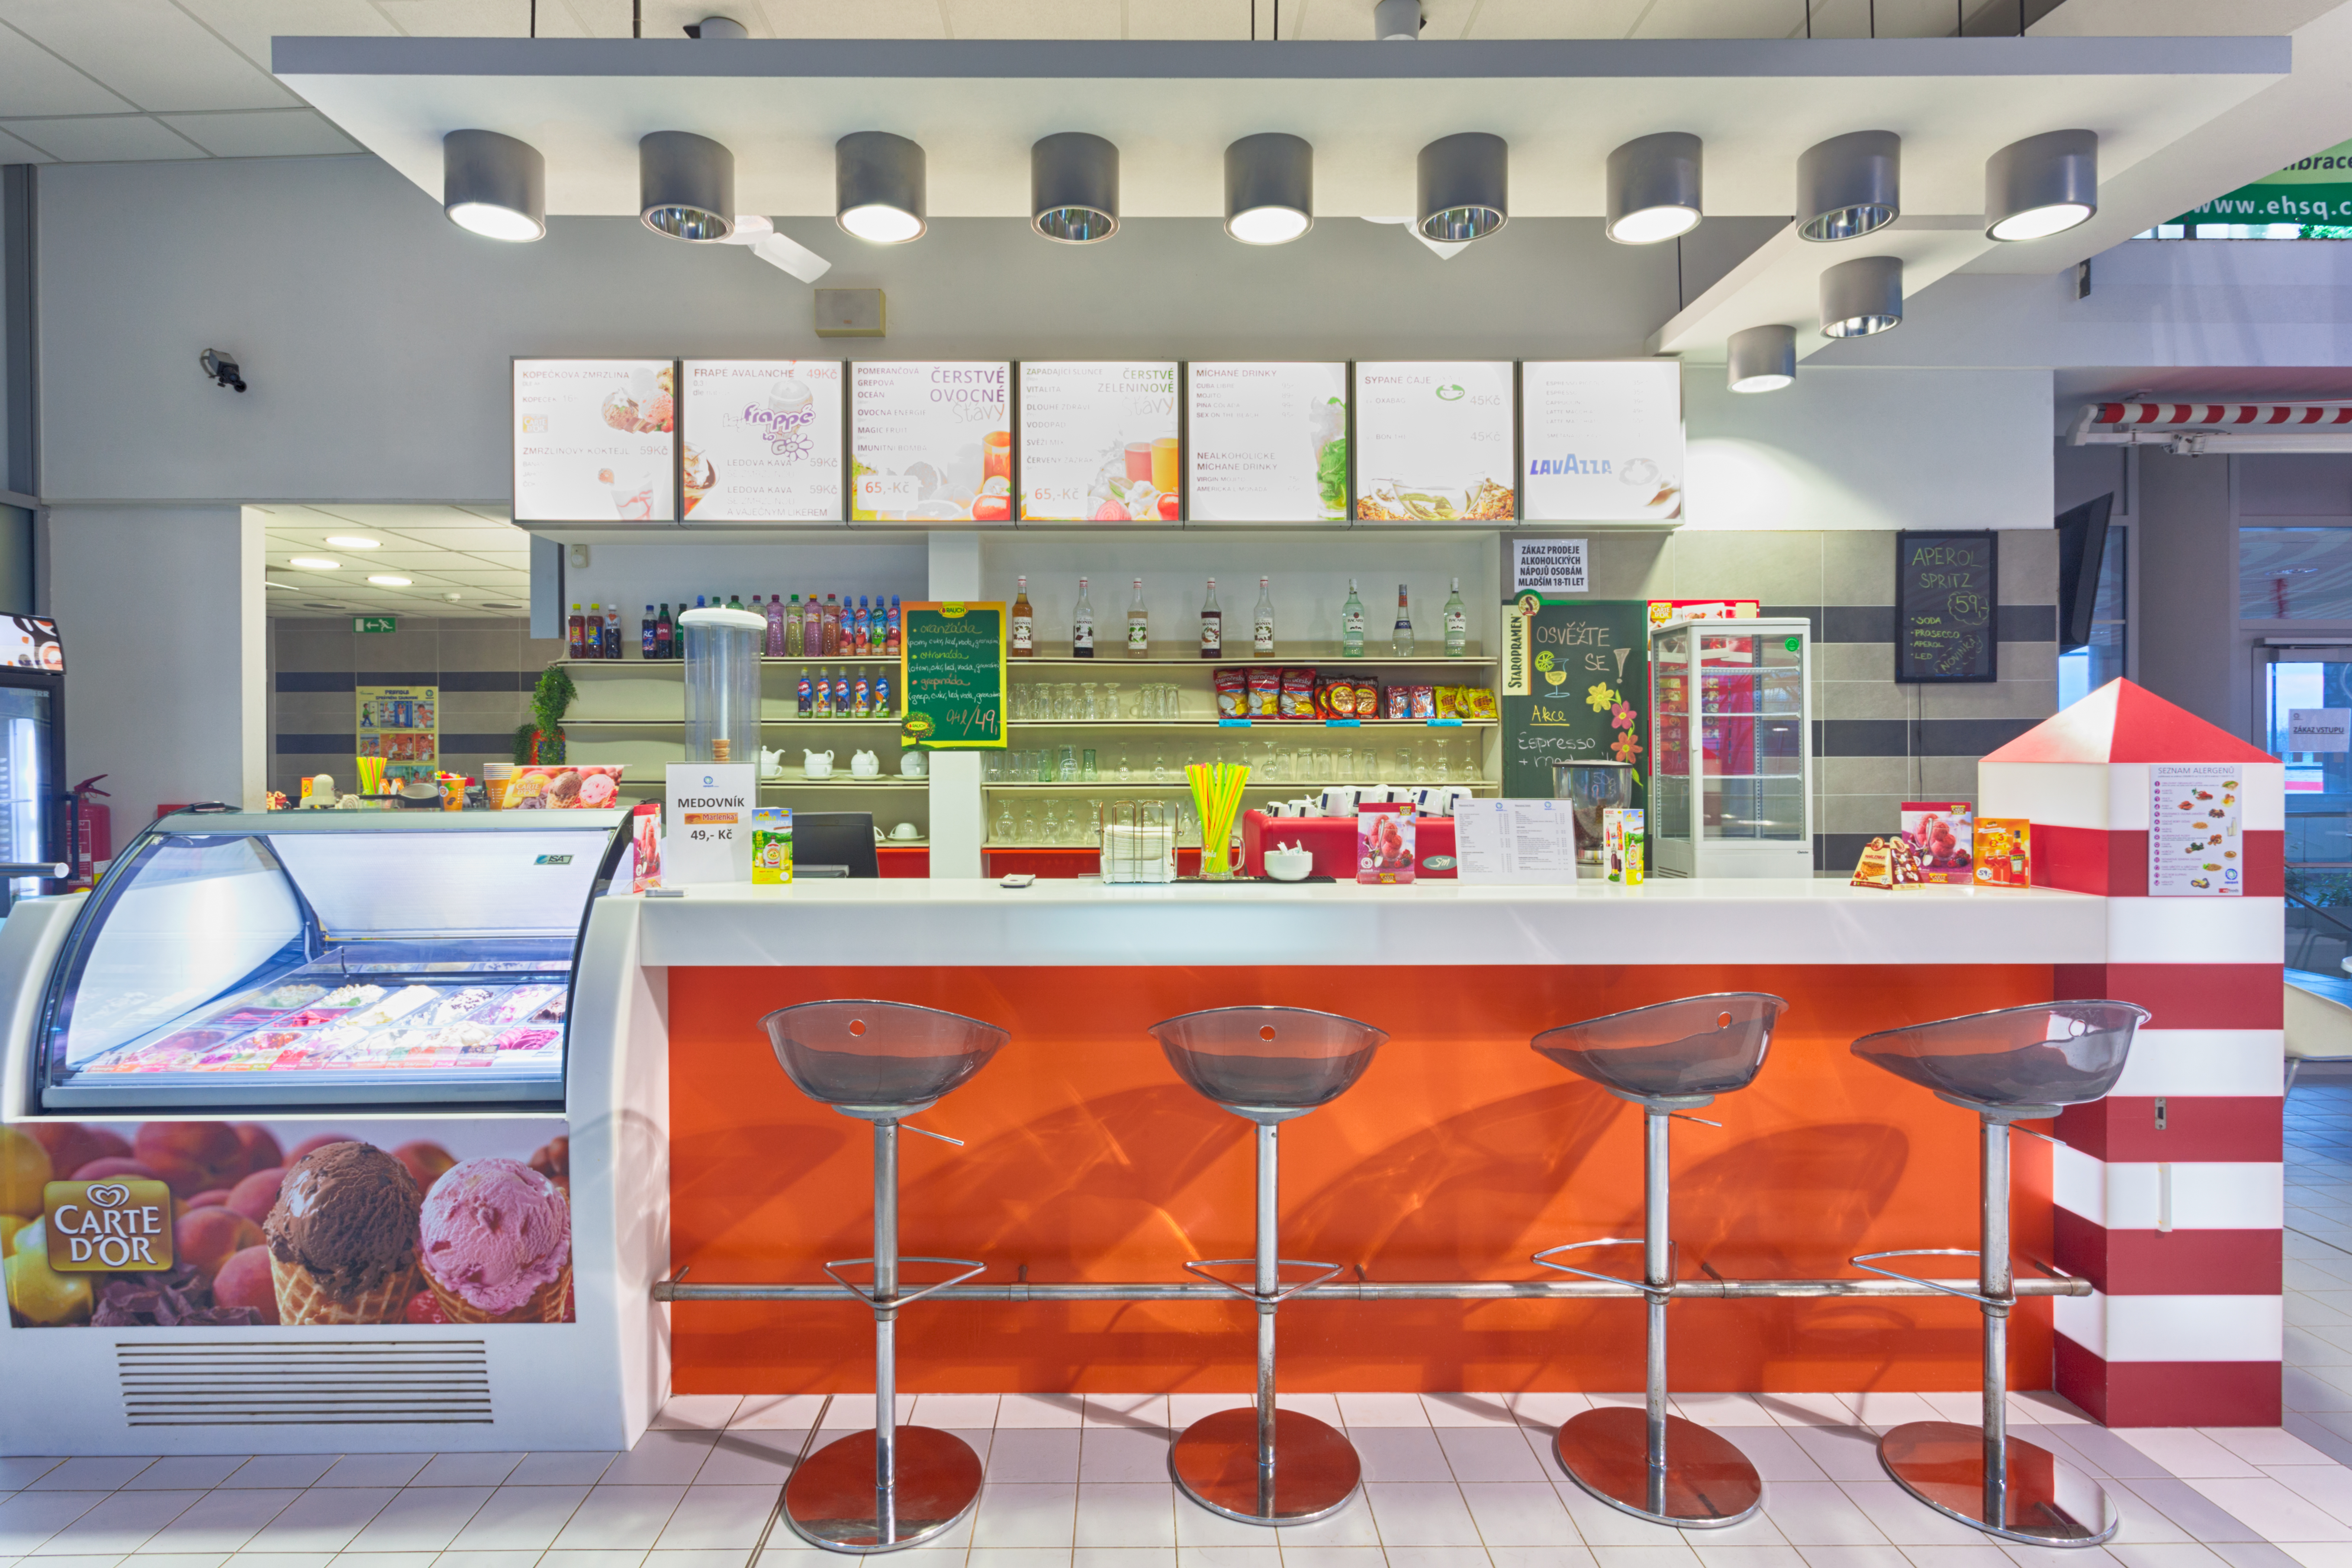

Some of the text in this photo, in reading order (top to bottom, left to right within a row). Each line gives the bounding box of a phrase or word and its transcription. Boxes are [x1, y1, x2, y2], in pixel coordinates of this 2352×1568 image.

[695, 367, 837, 379] FRAPÉ AVALANCHE 49Kč
[931, 366, 1004, 383] ČERSTVÉ
[1123, 367, 1174, 380] ČERSTVÉ
[1407, 375, 1431, 384] ČAJE
[1098, 381, 1174, 393] ZELENINOVÉ
[930, 385, 1004, 402] OVOCNÉ
[1470, 395, 1500, 405] 45Kč
[524, 418, 546, 426] CARTE
[744, 403, 814, 430] frappé
[1470, 431, 1500, 441] 45Kč
[640, 446, 668, 455] 59Kč
[810, 457, 837, 467] 59Kč
[810, 485, 837, 494] 59Kč
[1522, 545, 1545, 554] ZÁKAZ
[1521, 555, 1580, 565] ALKOHOLICKÝCH
[1912, 547, 1982, 568] APEROL
[1520, 565, 1582, 575] NÁPOJŮ OSOBÁM
[1519, 576, 1551, 586] MLADŠÍM
[1919, 573, 1972, 588] SPRITZ
[920, 620, 983, 634] oranžáda
[1537, 621, 1610, 647] OSVĚŽTE
[1914, 630, 1960, 639] PROSECCO
[920, 650, 969, 660] citronáda
[1940, 638, 1976, 671] NOVINKA
[921, 673, 971, 690] grepináda
[1532, 705, 1566, 722] Akce
[678, 796, 744, 808] MEDOVNÍK
[691, 829, 732, 841] 49,- Kč
[55, 1204, 161, 1238] CARTE
[70, 1233, 158, 1266] D'OR
